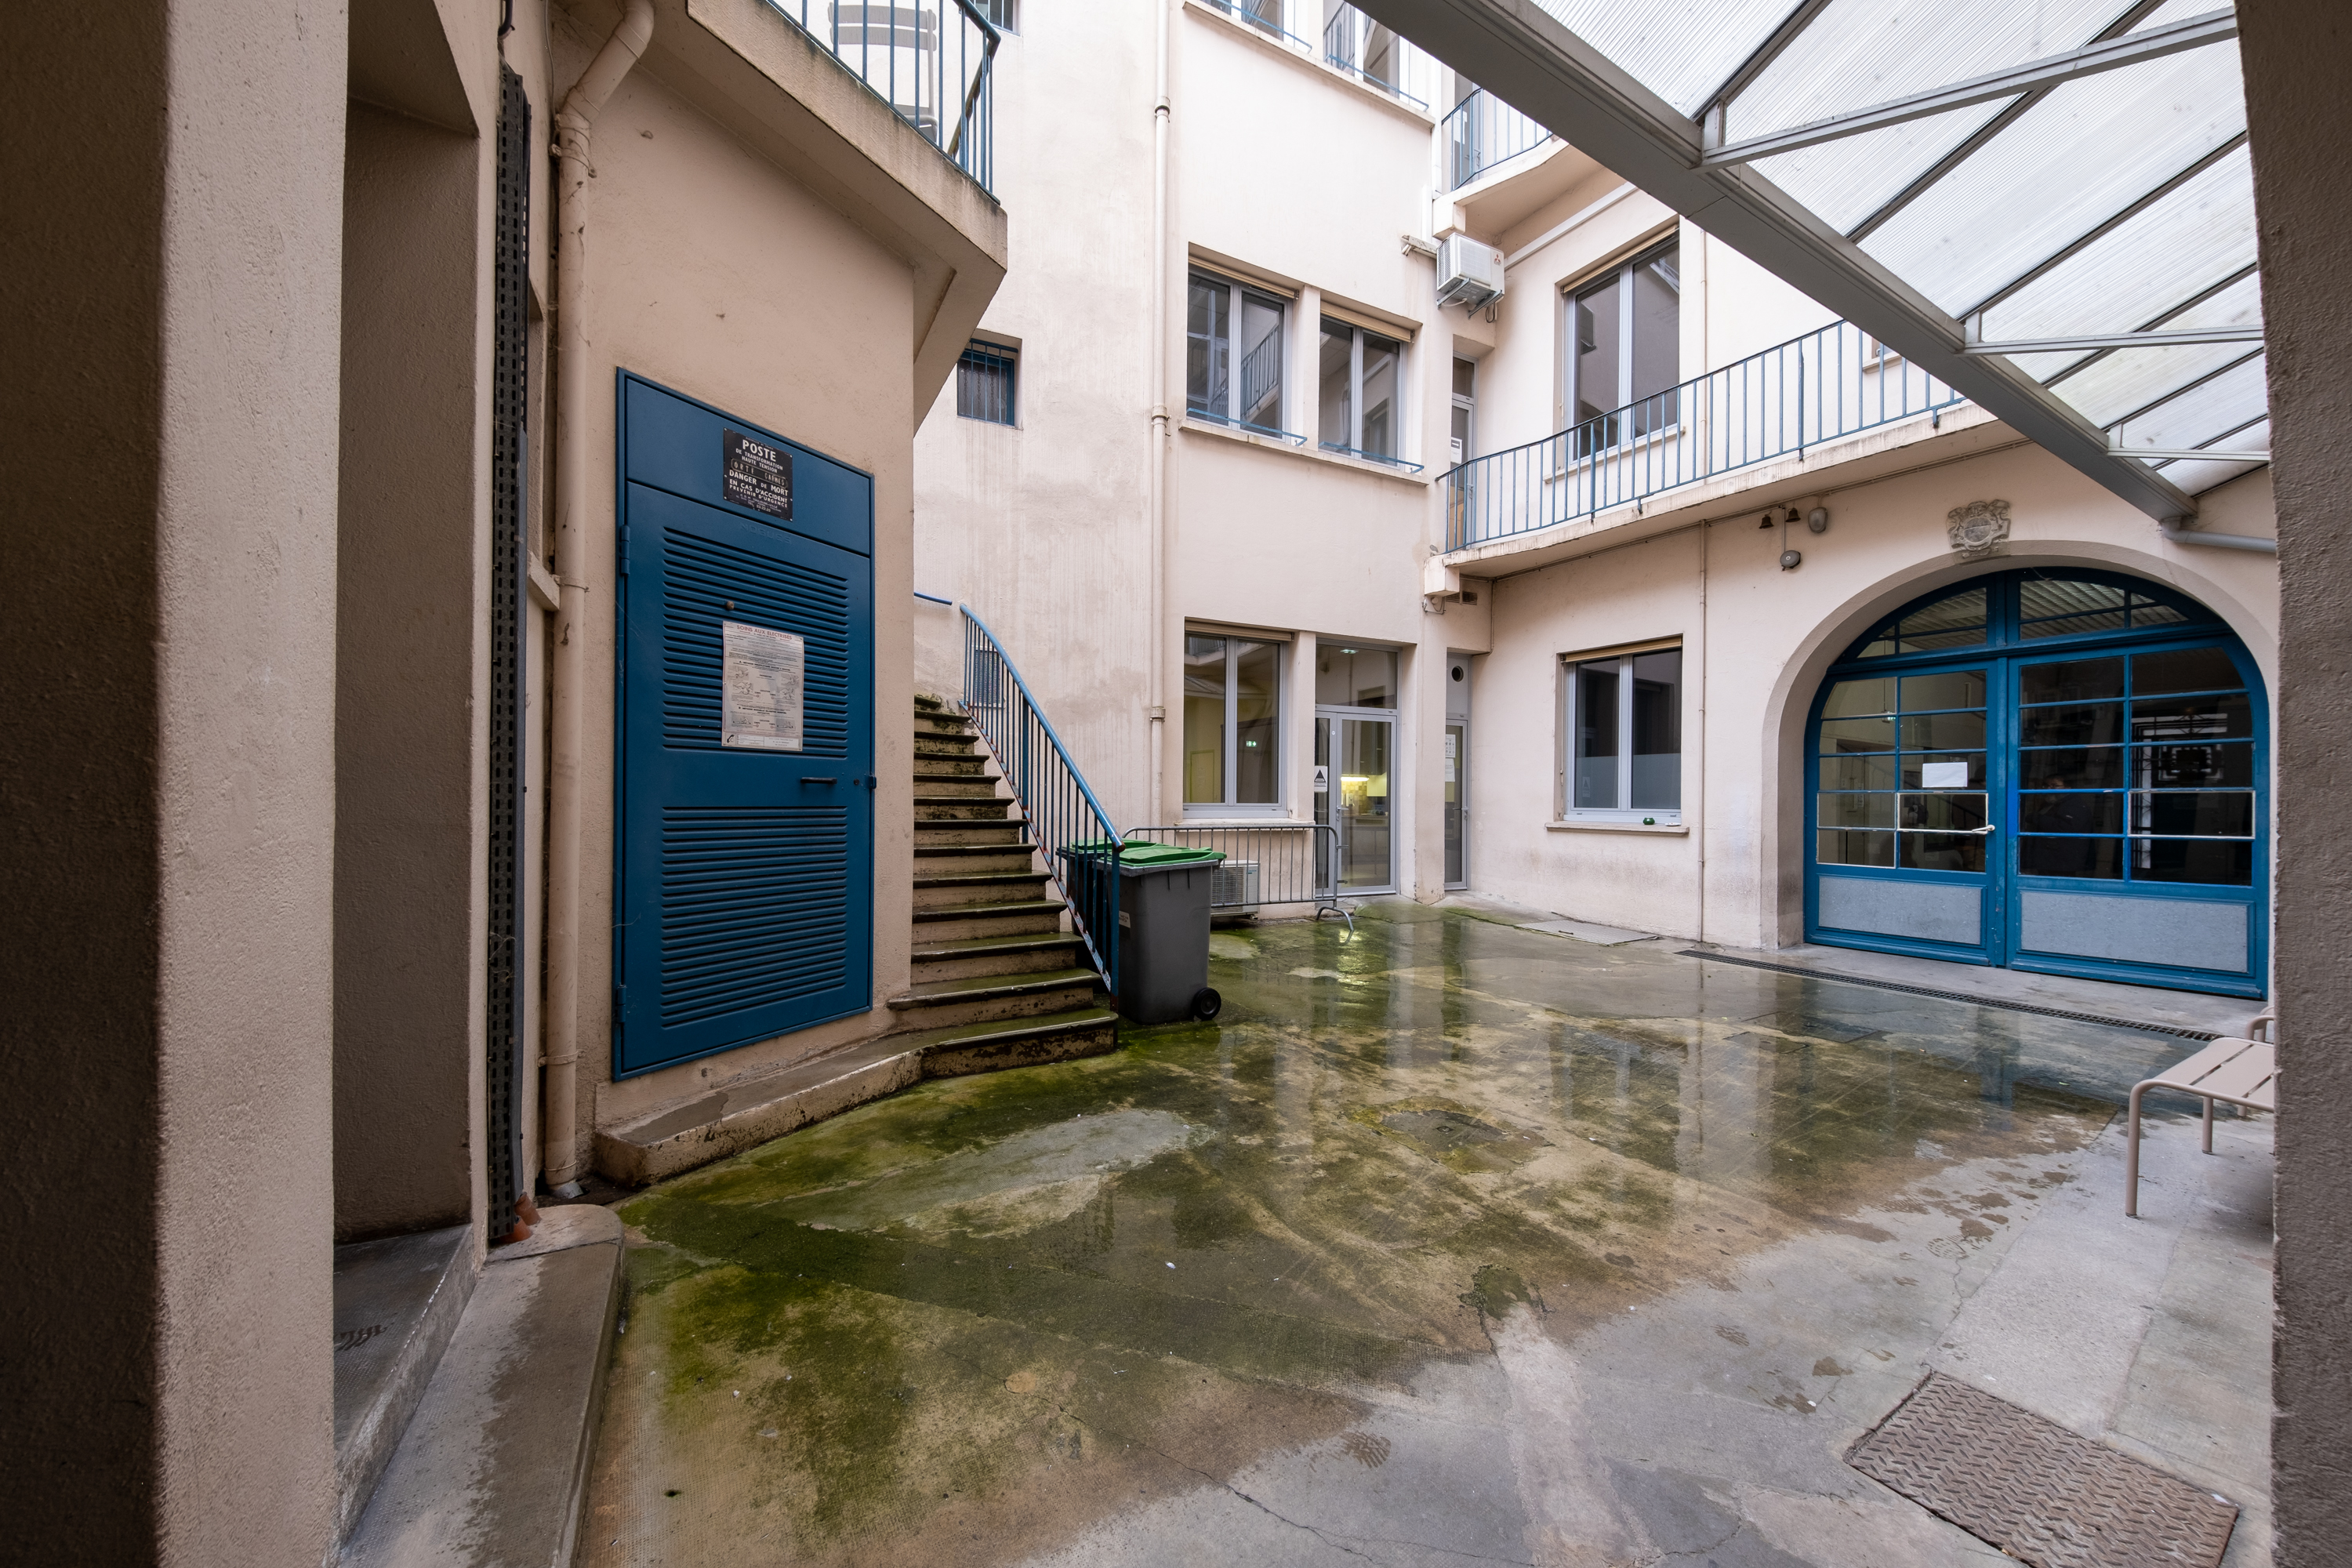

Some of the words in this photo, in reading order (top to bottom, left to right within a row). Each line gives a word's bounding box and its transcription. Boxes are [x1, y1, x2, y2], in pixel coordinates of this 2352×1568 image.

[742, 439, 776, 462] POSTE
[744, 452, 783, 470] TRANSFORMATION
[742, 456, 757, 465] HAUTE
[759, 463, 777, 473] TENSION
[729, 469, 757, 485] DANGER
[771, 485, 788, 496] MORT
[740, 482, 753, 492] CAS
[755, 488, 788, 503] D'ACCIDENT
[729, 484, 756, 497] PREVENIR
[758, 494, 788, 508] D'URGENCE
